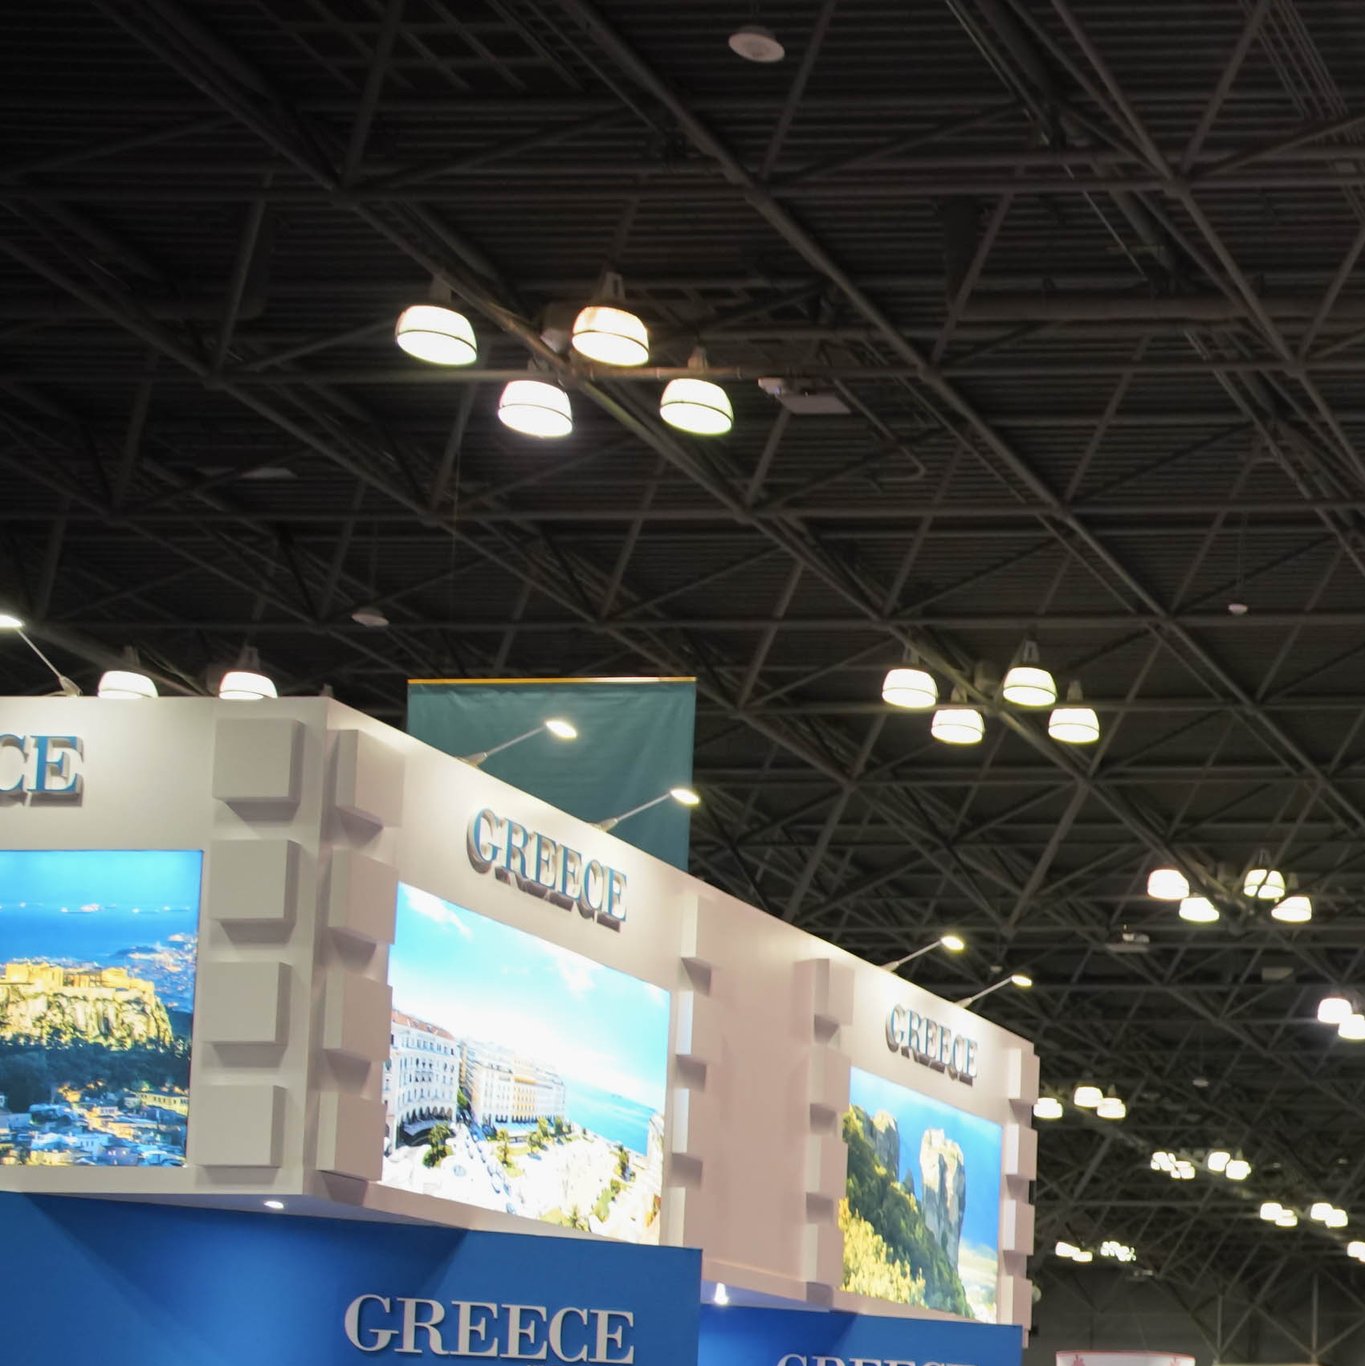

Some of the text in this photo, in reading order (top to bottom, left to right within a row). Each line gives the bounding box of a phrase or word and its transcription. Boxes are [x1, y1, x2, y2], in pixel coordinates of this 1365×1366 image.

[468, 808, 627, 924] GREECE
[887, 1003, 978, 1079] GREECE
[344, 1294, 634, 1364] GREECE
